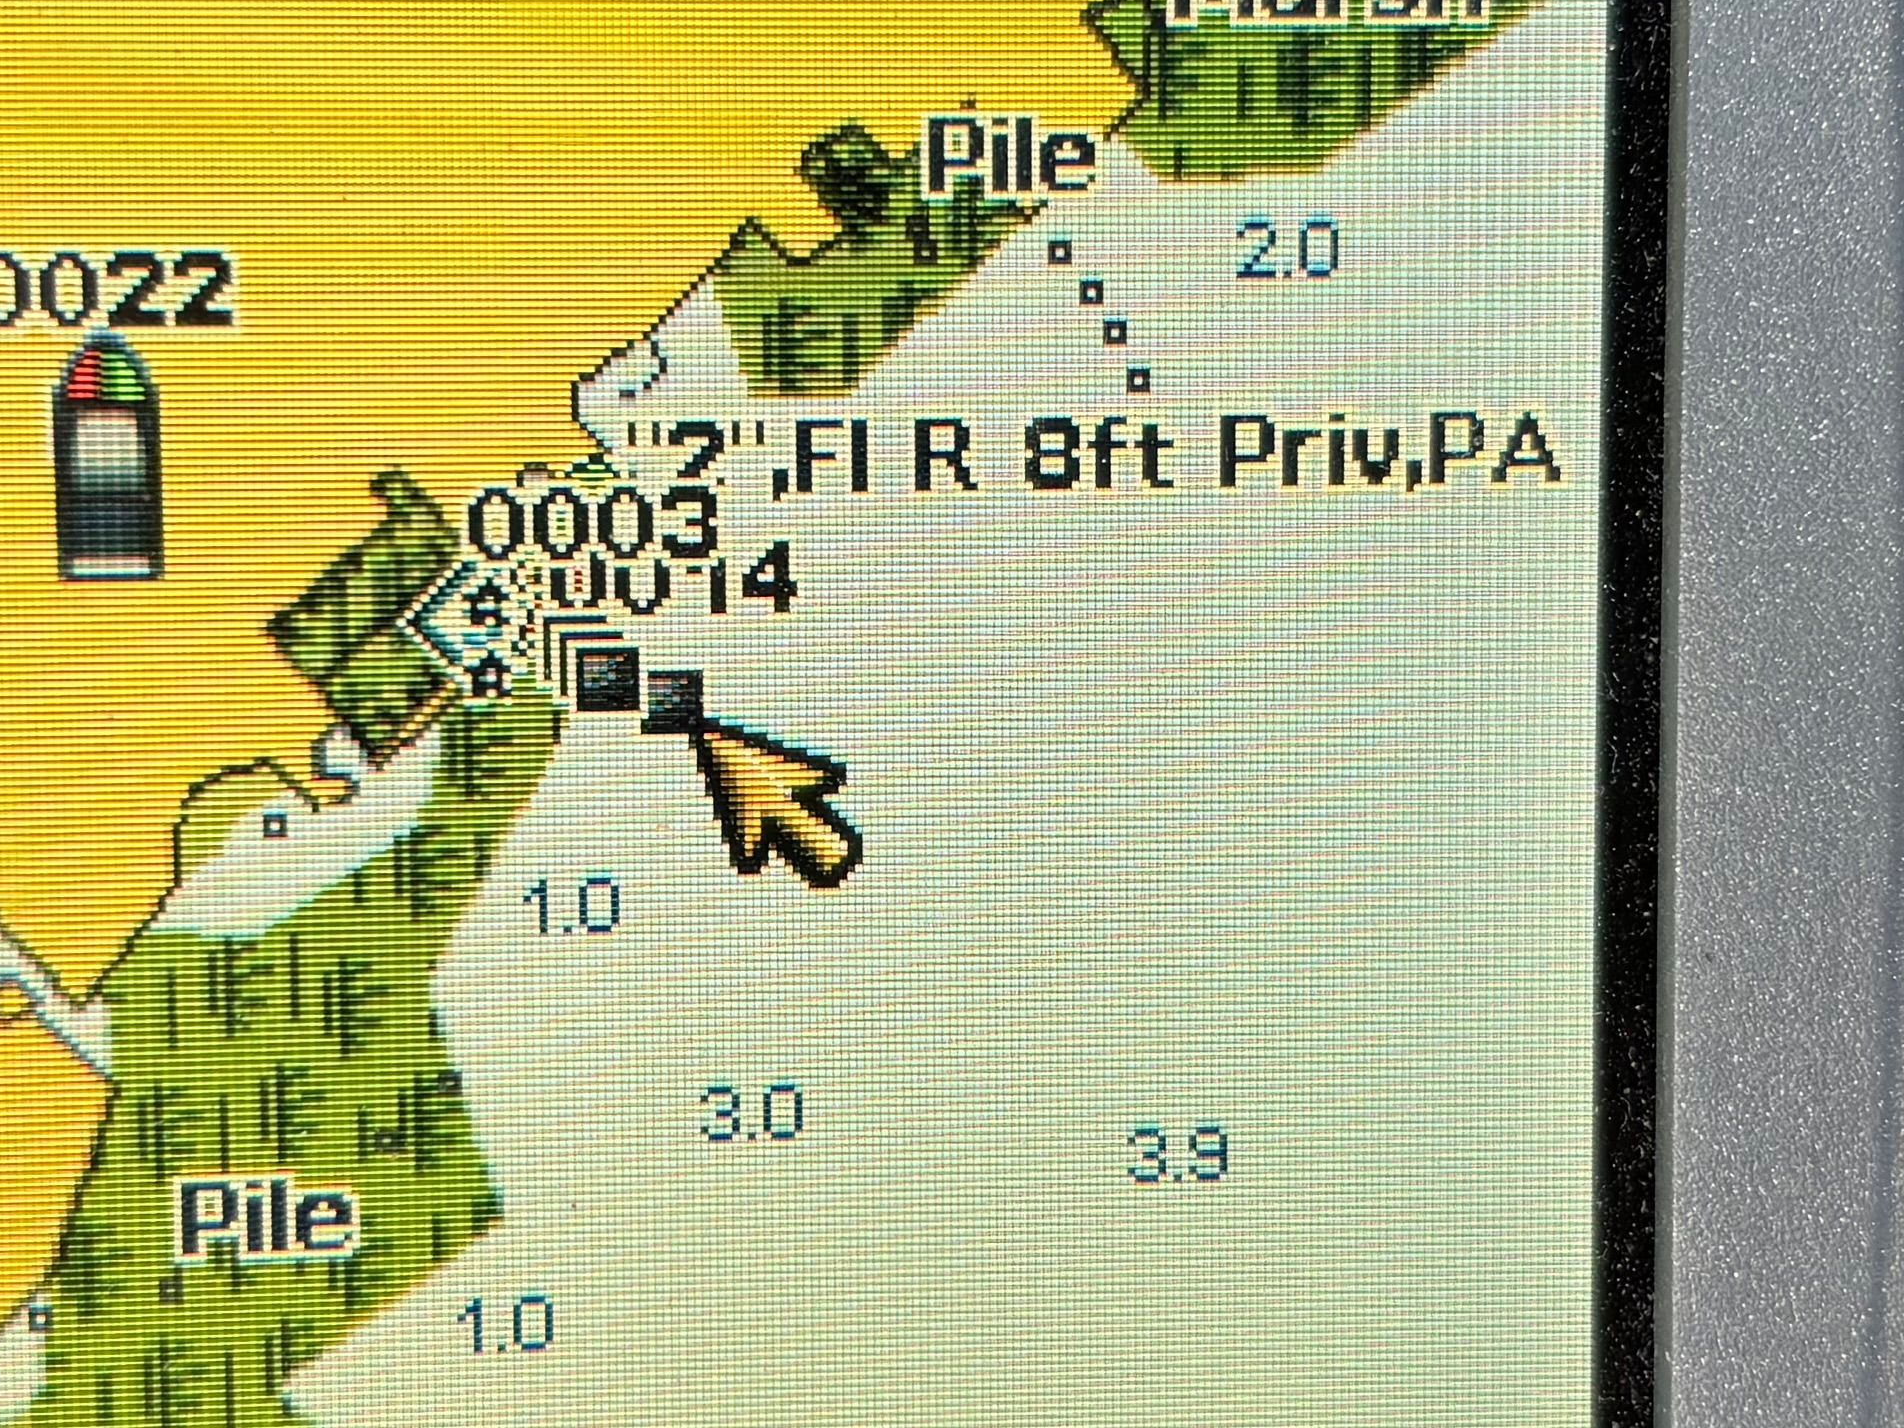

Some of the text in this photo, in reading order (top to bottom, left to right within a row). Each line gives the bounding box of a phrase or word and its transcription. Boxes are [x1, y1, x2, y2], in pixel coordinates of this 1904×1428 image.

[924, 116, 1098, 194] Pile
[1236, 214, 1342, 279] 2.0
[914, 417, 978, 492] R
[1023, 415, 1174, 490] 8ft
[466, 486, 720, 560] 0003
[521, 875, 621, 935] 1.0
[699, 1082, 803, 1142] 3.0
[1126, 1125, 1228, 1184] 3.9
[179, 1178, 355, 1256] Pile
[456, 1294, 554, 1354] 1.0
